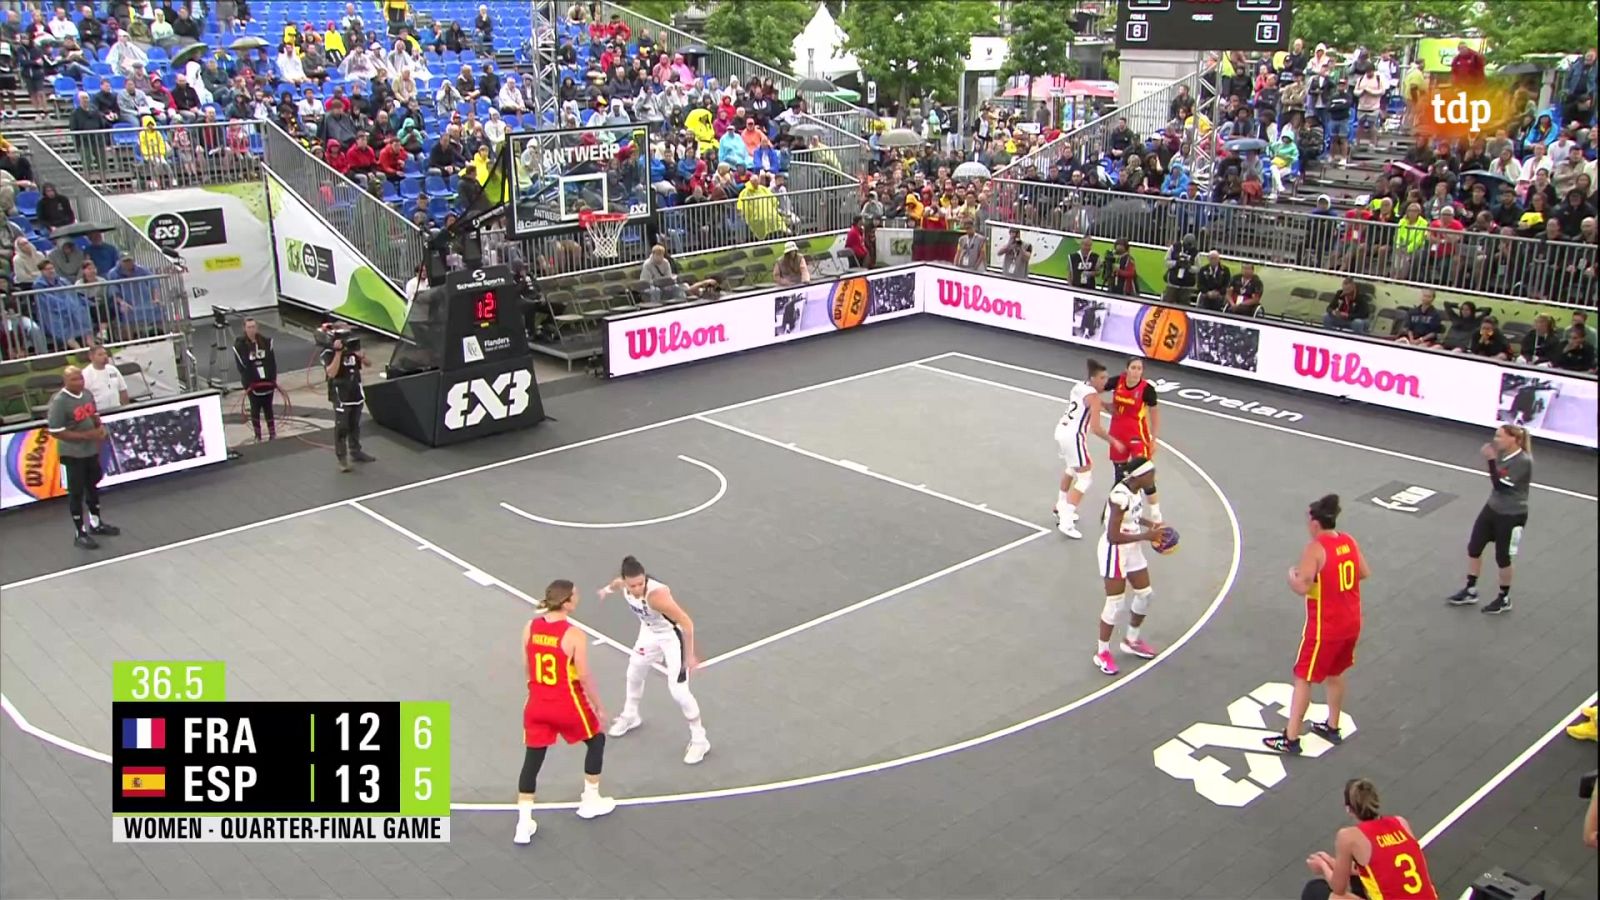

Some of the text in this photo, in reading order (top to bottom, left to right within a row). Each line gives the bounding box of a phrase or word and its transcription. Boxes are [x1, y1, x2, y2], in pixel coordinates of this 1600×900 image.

[543, 143, 620, 166] ANTWERP
[936, 278, 1022, 321] Wilson
[625, 321, 727, 360] Wilson
[1293, 342, 1421, 400] Wilson
[1177, 388, 1304, 422] Crelan
[1338, 560, 1355, 592] 10
[535, 653, 558, 685] 13
[1395, 853, 1423, 894] 3
